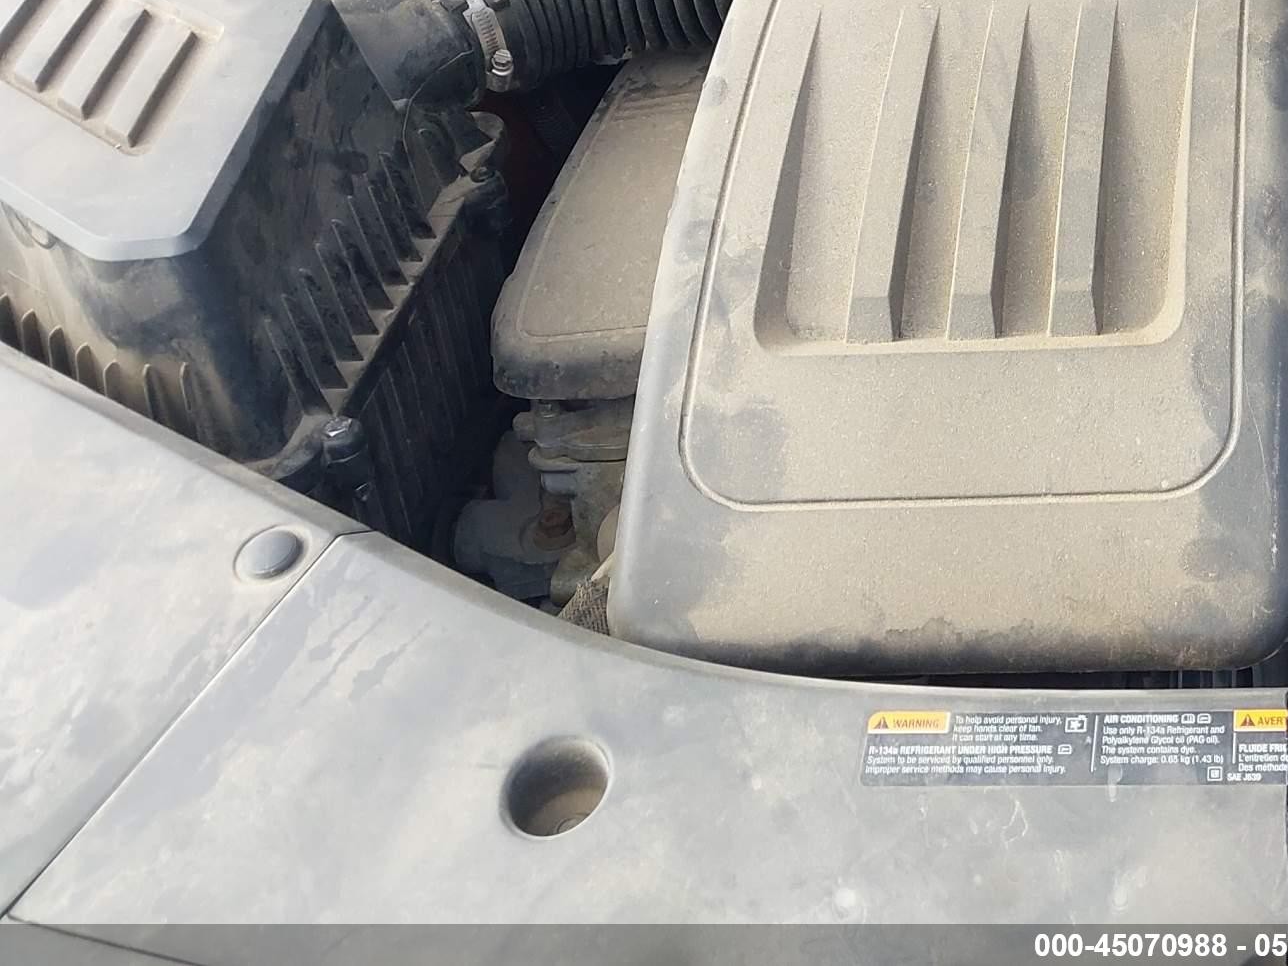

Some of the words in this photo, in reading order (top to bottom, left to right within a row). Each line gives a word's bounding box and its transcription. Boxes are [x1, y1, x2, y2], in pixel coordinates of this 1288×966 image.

[894, 718, 938, 728] WARNING
[1104, 714, 1118, 724] AIR
[1120, 714, 1178, 724] CONDITIONING
[868, 746, 898, 754] R-134a
[900, 746, 956, 754] REFRIGERANT
[958, 746, 986, 754] UNDER
[988, 746, 1008, 754] HIGH
[1010, 746, 1052, 754] PRESSURE
[1238, 744, 1268, 752] FLUIDE
